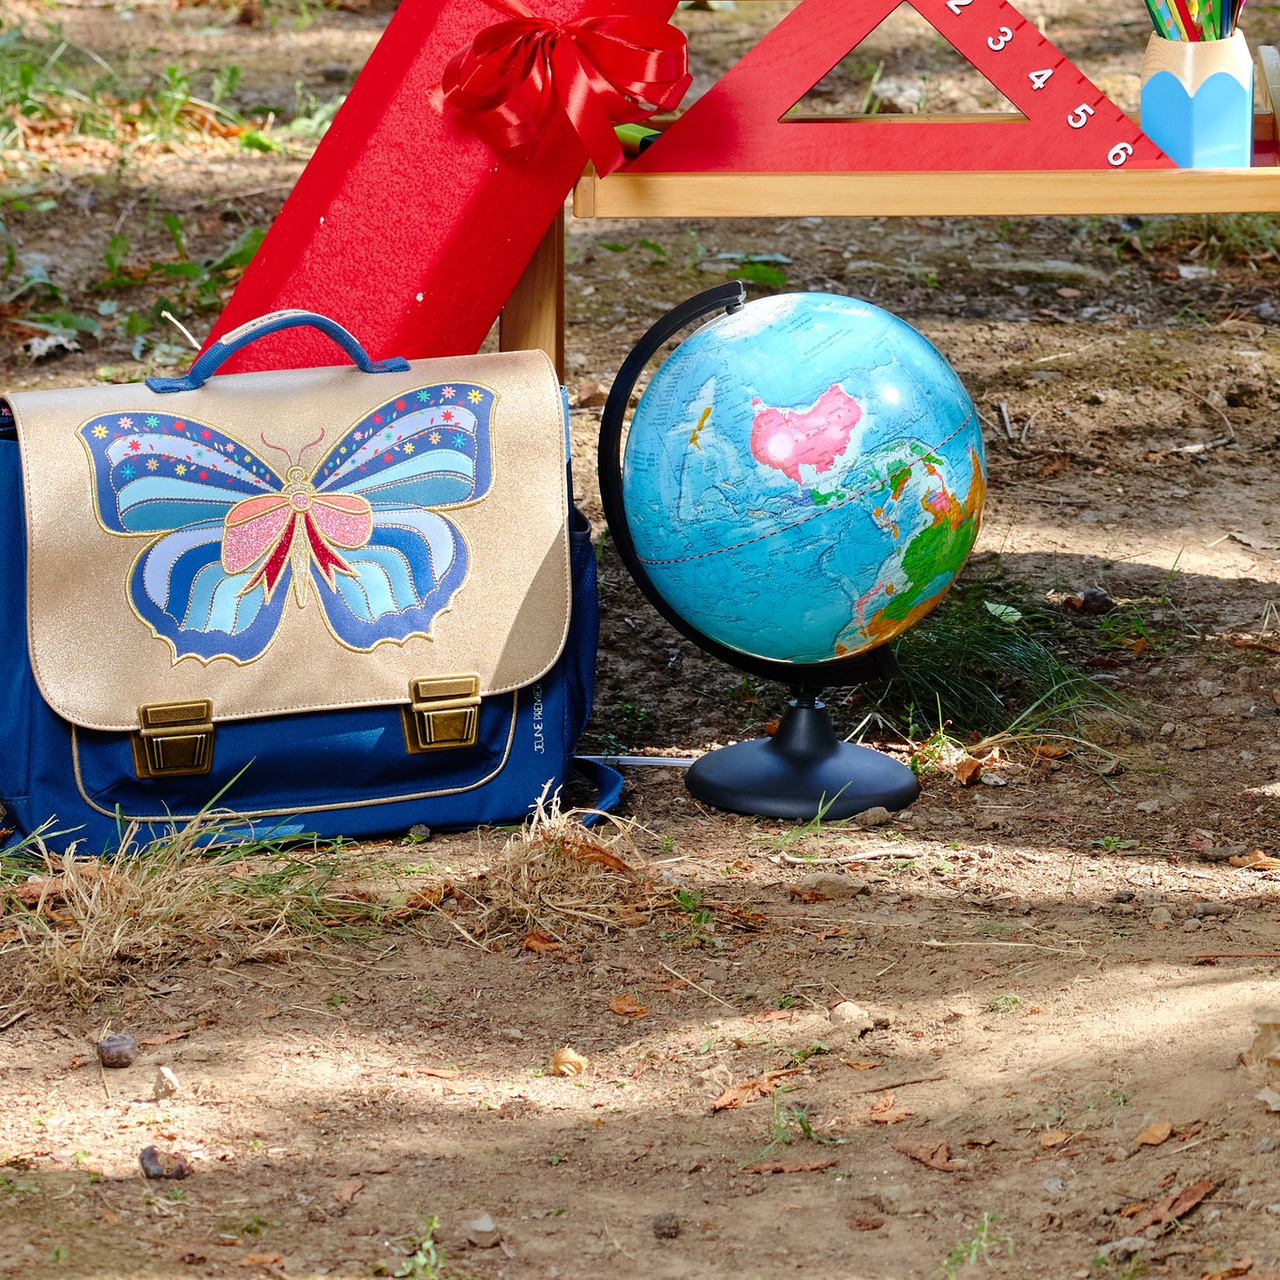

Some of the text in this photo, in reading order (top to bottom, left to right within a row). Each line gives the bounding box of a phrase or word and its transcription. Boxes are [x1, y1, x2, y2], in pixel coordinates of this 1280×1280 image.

[987, 26, 1014, 53] 3
[1028, 66, 1054, 92] 4
[1068, 103, 1095, 130] 5
[1107, 141, 1134, 168] 6
[532, 722, 545, 754] JEUNE
